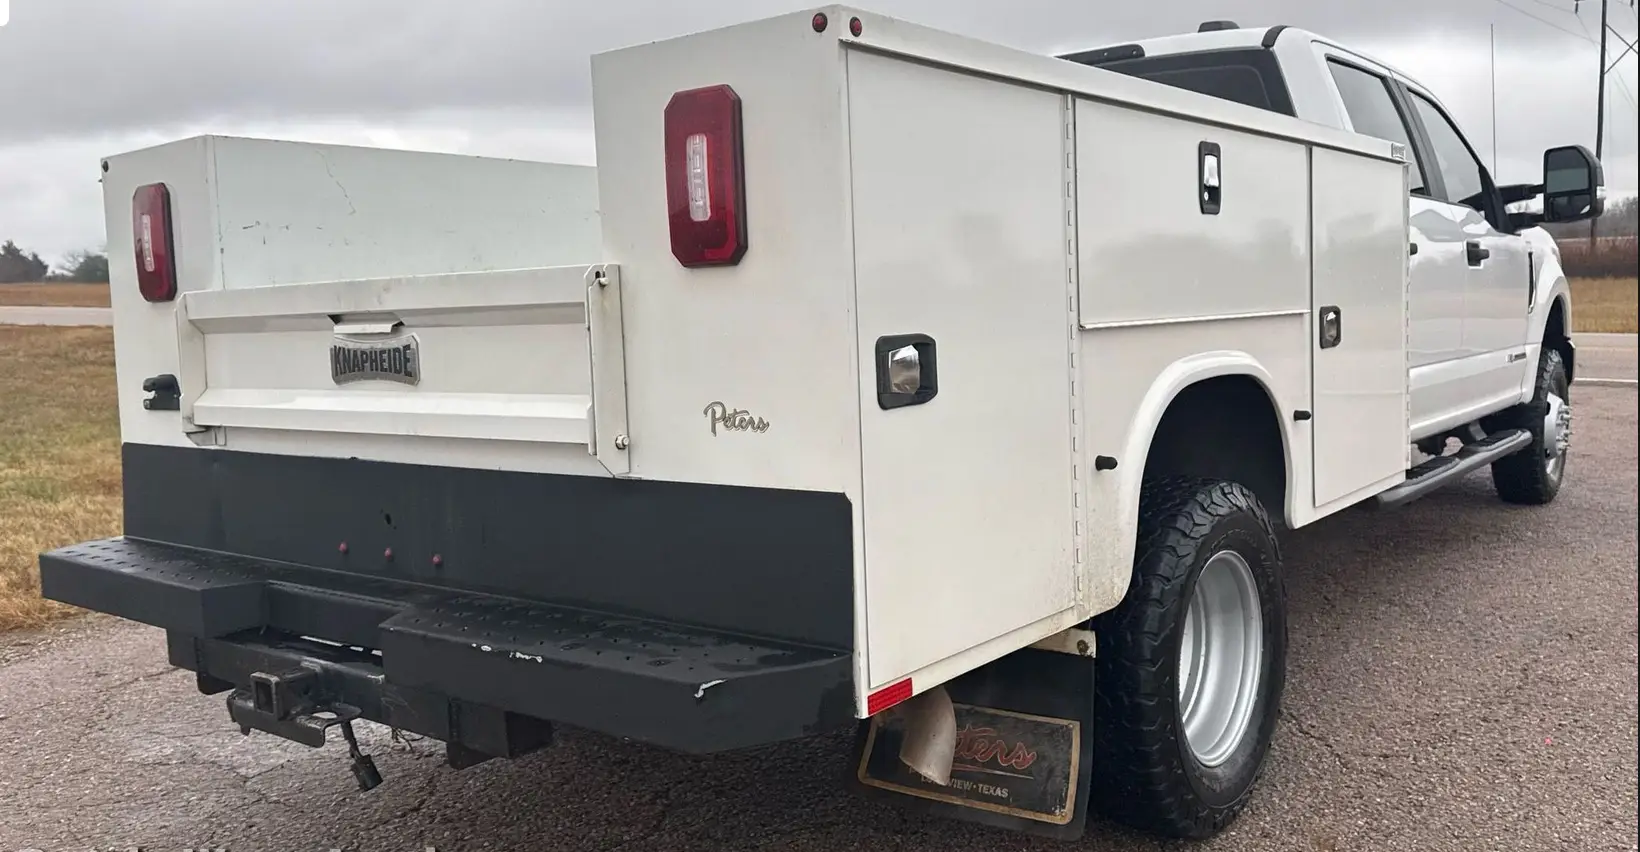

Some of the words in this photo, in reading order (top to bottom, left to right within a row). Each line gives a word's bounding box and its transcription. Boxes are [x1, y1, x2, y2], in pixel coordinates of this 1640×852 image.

[333, 343, 413, 378] KNAPHEIDE
[703, 400, 770, 437] Peters
[954, 723, 1037, 770] ters
[978, 783, 1009, 798] TEXAS
